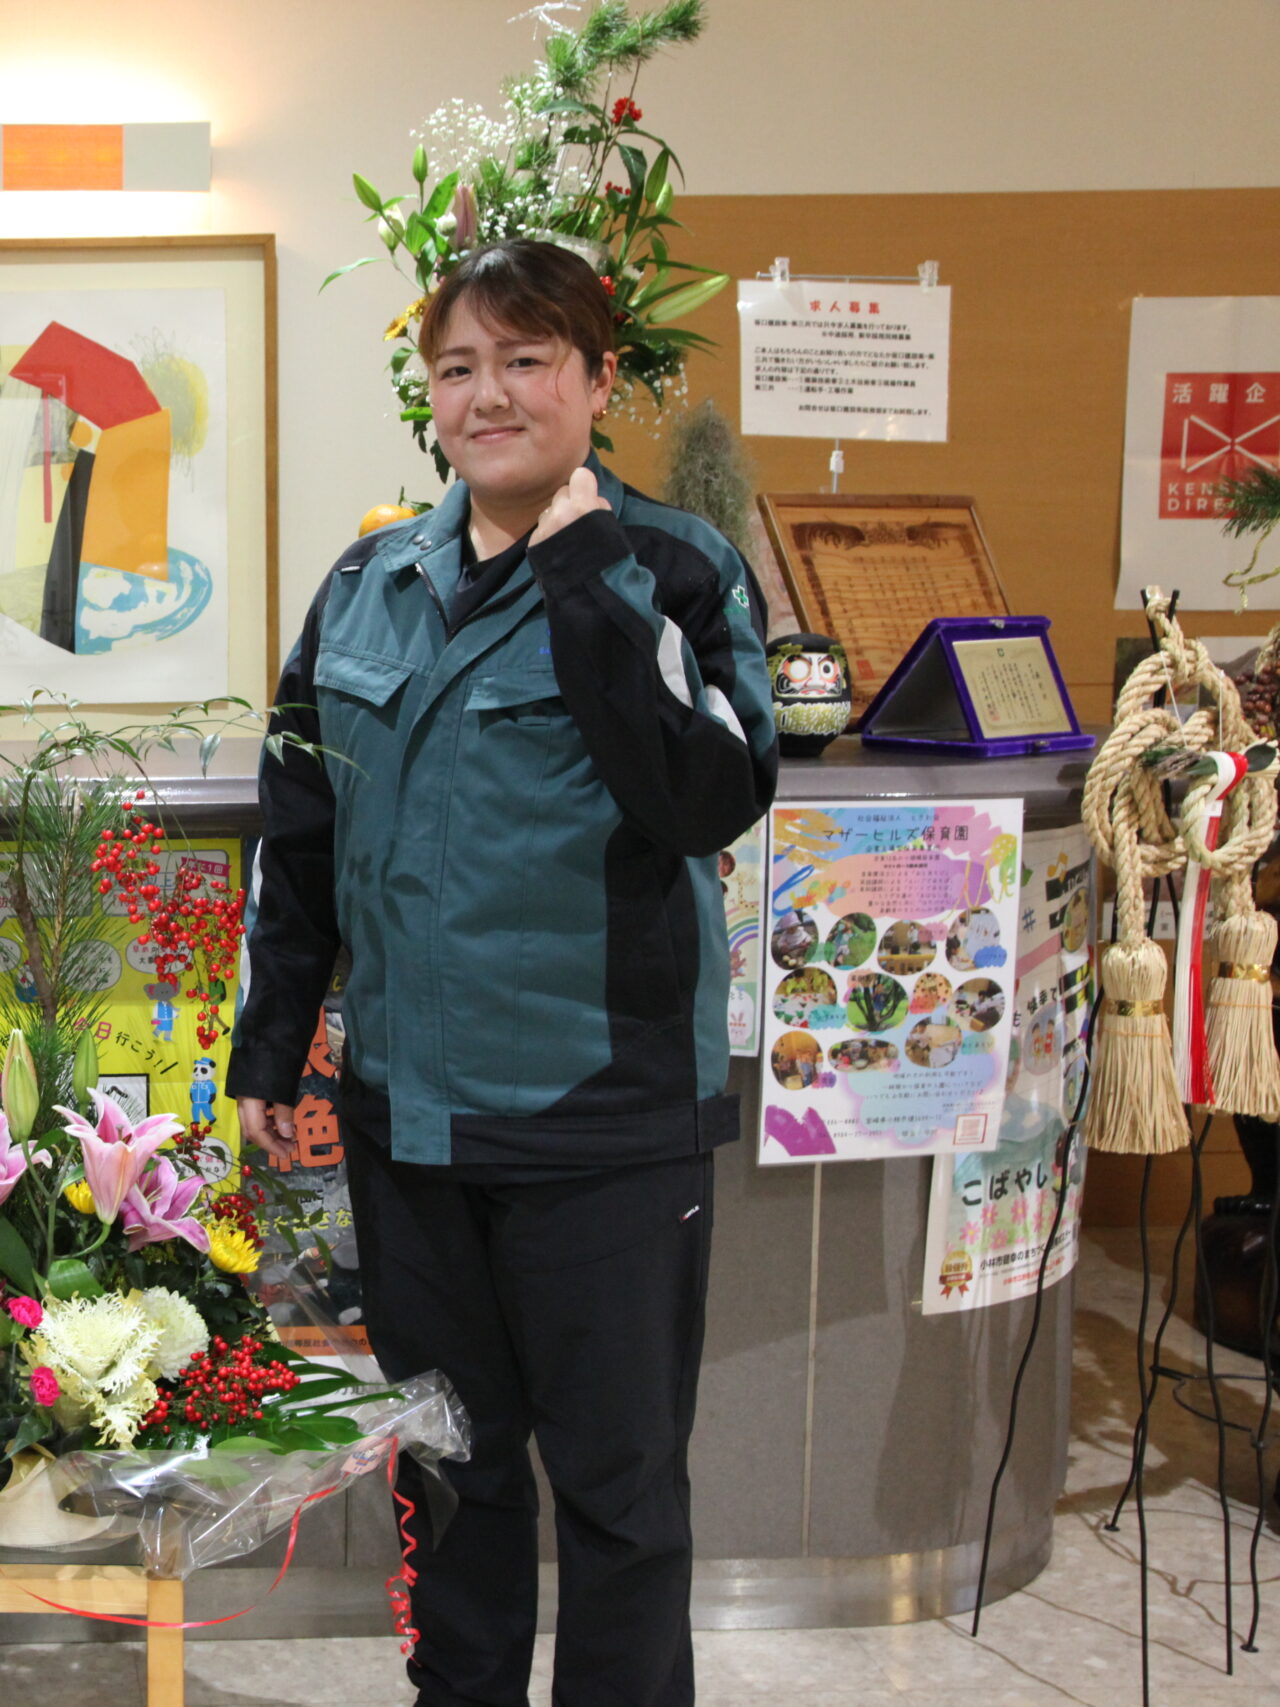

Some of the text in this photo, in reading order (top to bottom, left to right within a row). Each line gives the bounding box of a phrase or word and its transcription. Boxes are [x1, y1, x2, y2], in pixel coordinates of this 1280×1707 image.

[822, 825, 969, 842] マザーヒルズ保育園
[961, 1163, 1048, 1206] こばやし
